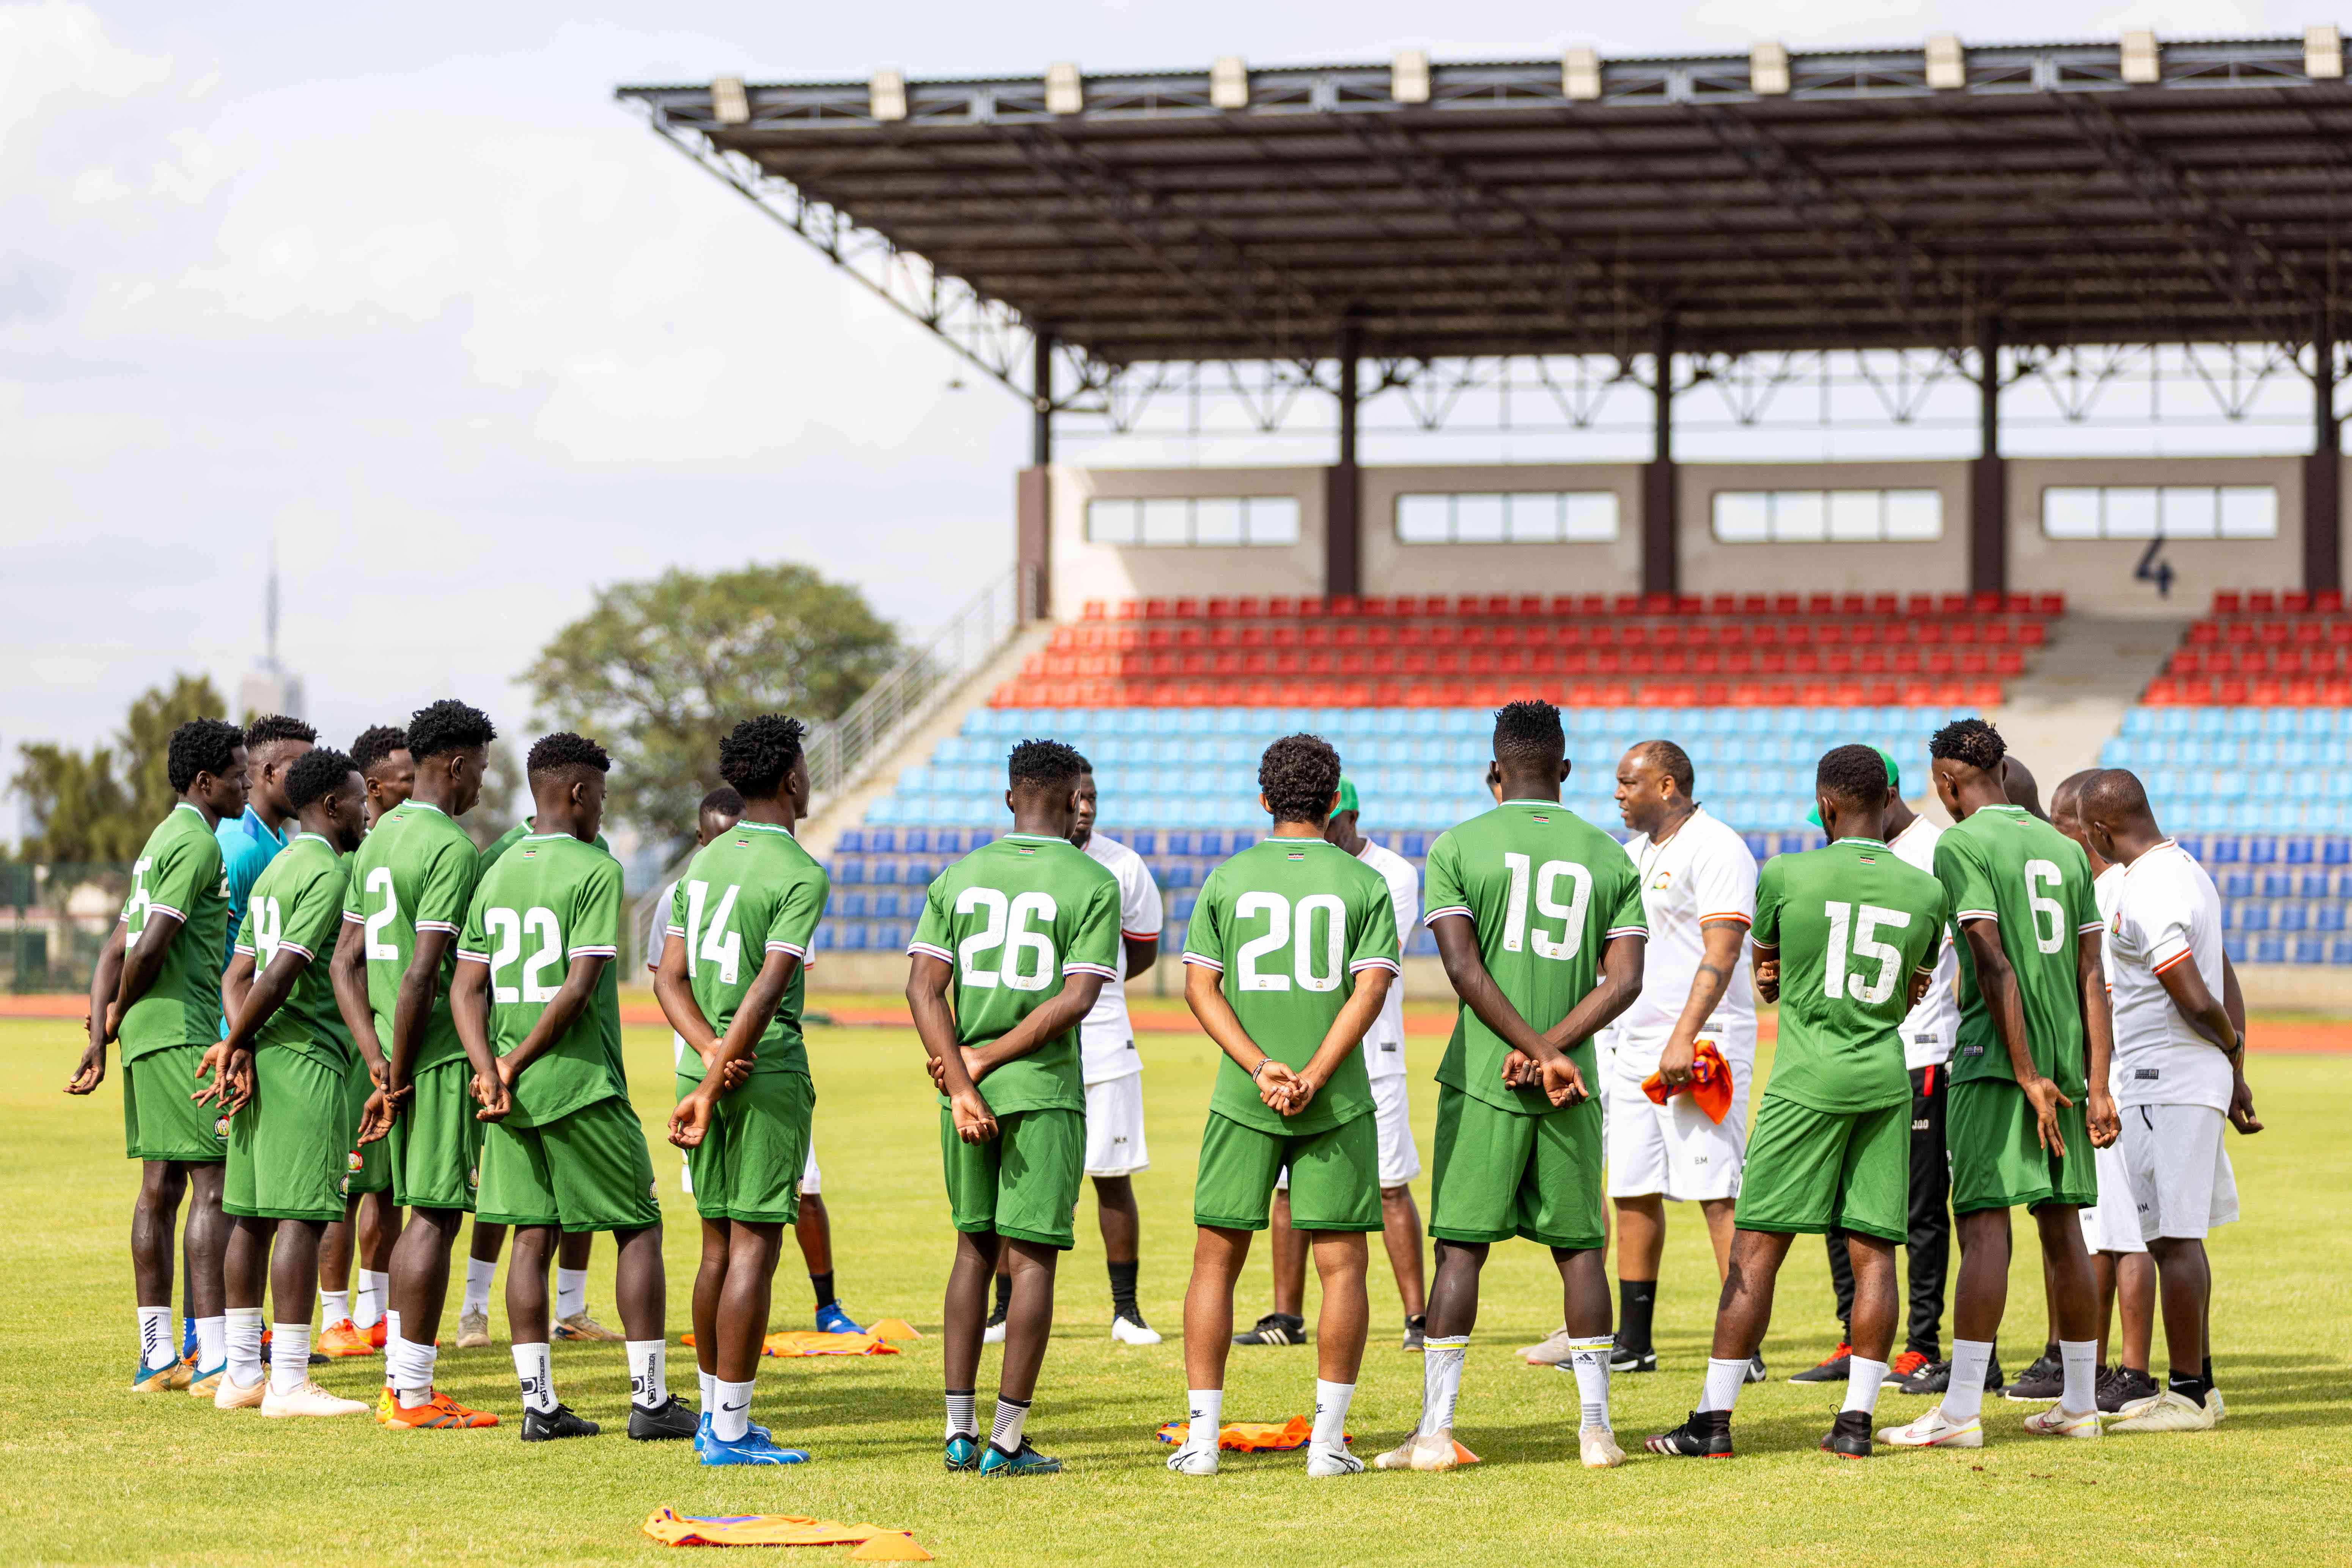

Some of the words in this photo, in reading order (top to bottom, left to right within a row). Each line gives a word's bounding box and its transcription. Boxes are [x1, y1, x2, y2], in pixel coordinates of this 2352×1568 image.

[2135, 536, 2174, 598] 4
[365, 867, 398, 960] 2
[484, 906, 562, 1005] 22
[687, 879, 741, 984] 14
[956, 887, 1057, 991] 26
[1236, 891, 1346, 991] 20
[1504, 852, 1592, 960] 19
[1825, 901, 1911, 1004] 15
[2025, 859, 2064, 953] 6
[648, 1353, 656, 1389] TAPEDESIGN
